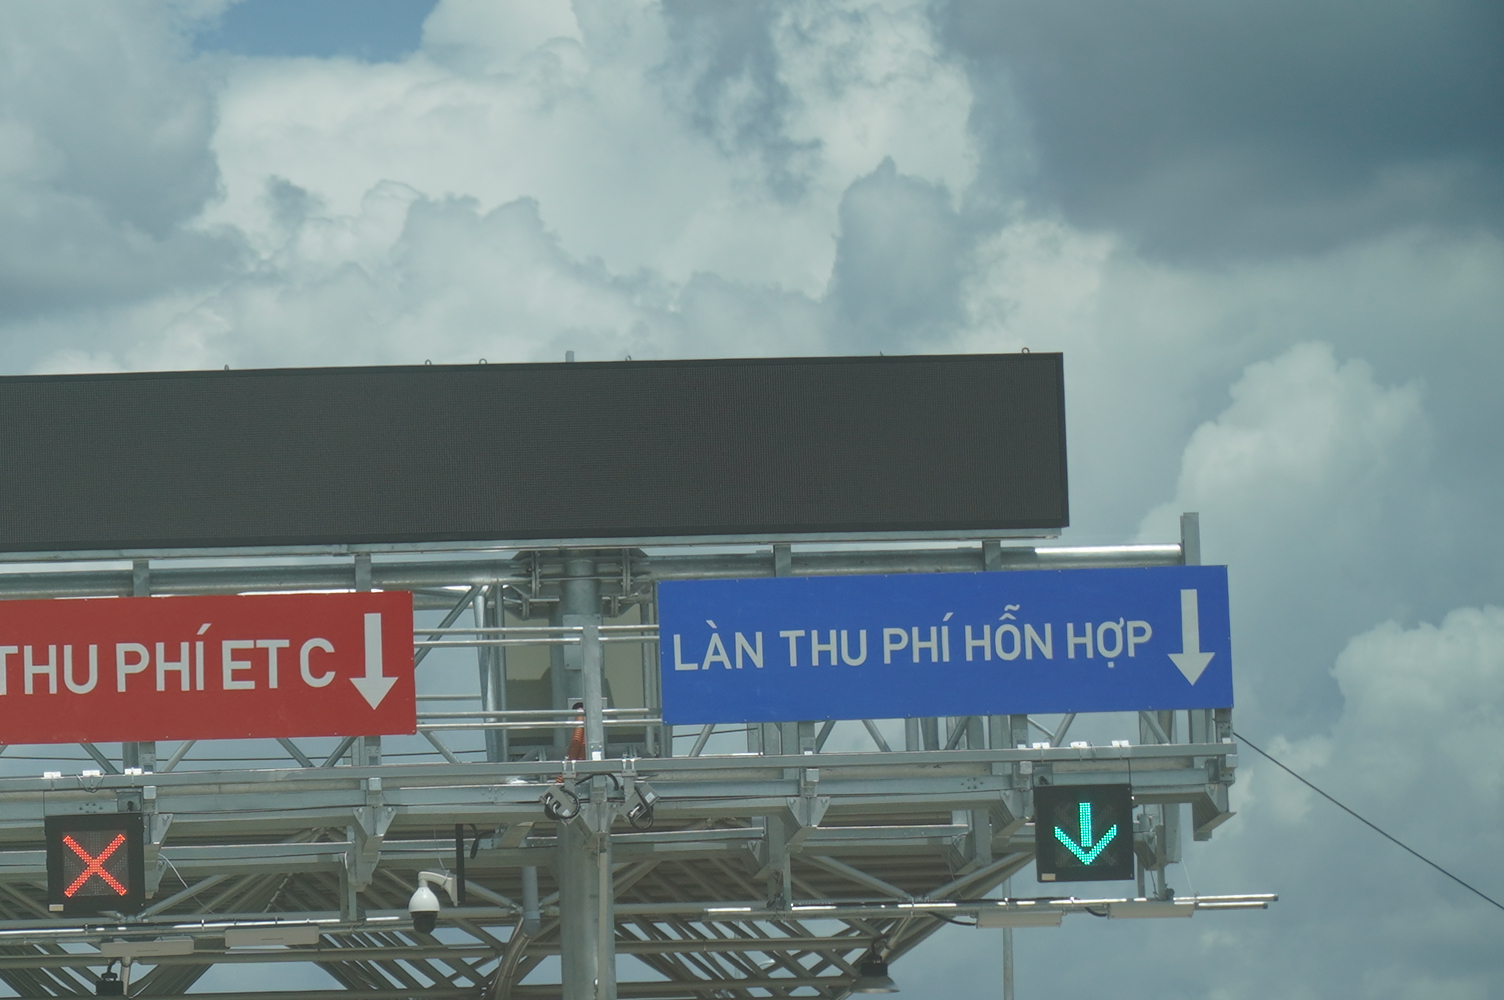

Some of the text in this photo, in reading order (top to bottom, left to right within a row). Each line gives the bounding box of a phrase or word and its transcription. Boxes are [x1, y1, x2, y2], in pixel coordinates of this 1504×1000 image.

[115, 623, 212, 692] PHÍ
[222, 638, 336, 690] ETC
[673, 604, 1152, 671] LÀN THU PHÍ HỖN HỢP
